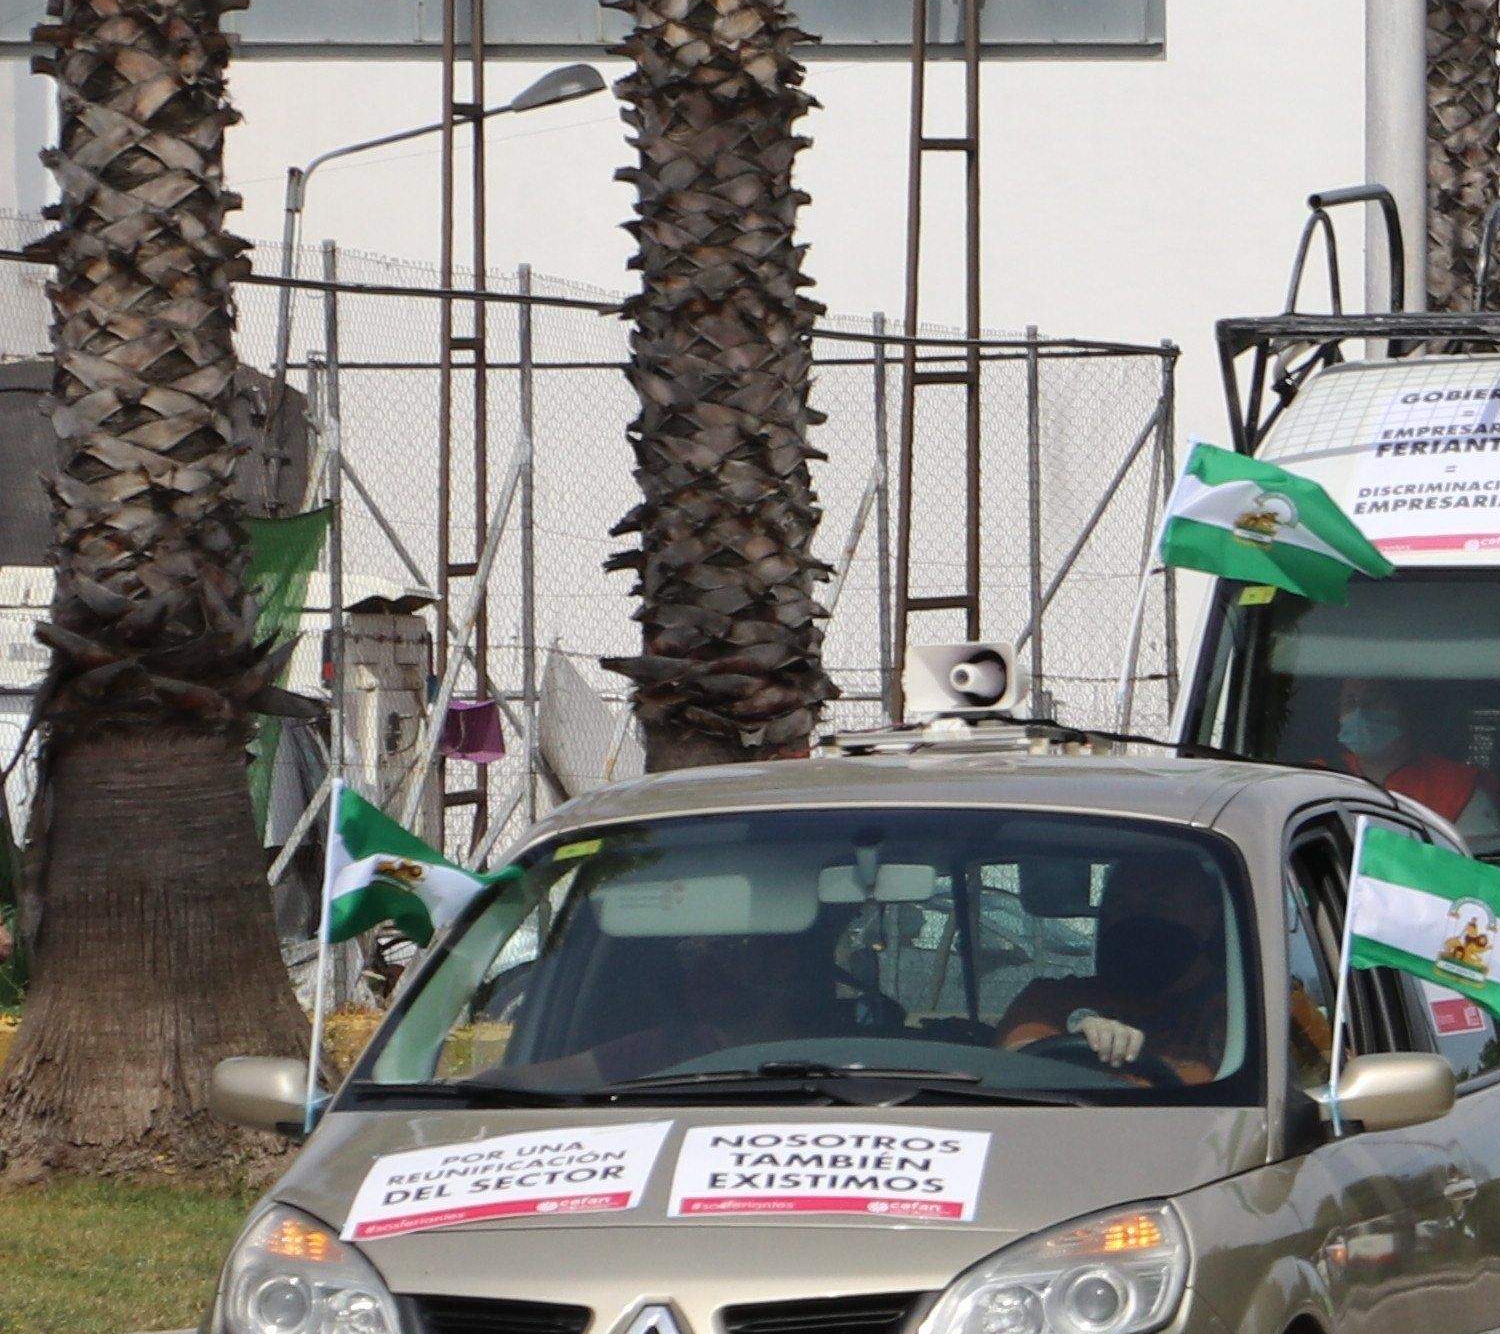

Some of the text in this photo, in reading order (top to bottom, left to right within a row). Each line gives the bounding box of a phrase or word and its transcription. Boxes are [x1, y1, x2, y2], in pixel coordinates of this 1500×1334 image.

[440, 1140, 585, 1166] POR UNA
[709, 1133, 961, 1154] NOSOTROS
[386, 1149, 627, 1187] REUNIFICACIÓN
[730, 1151, 933, 1172] TAMBIÉN
[381, 1165, 627, 1207] DEL SECTOR
[708, 1171, 945, 1194] EXISTIMOS
